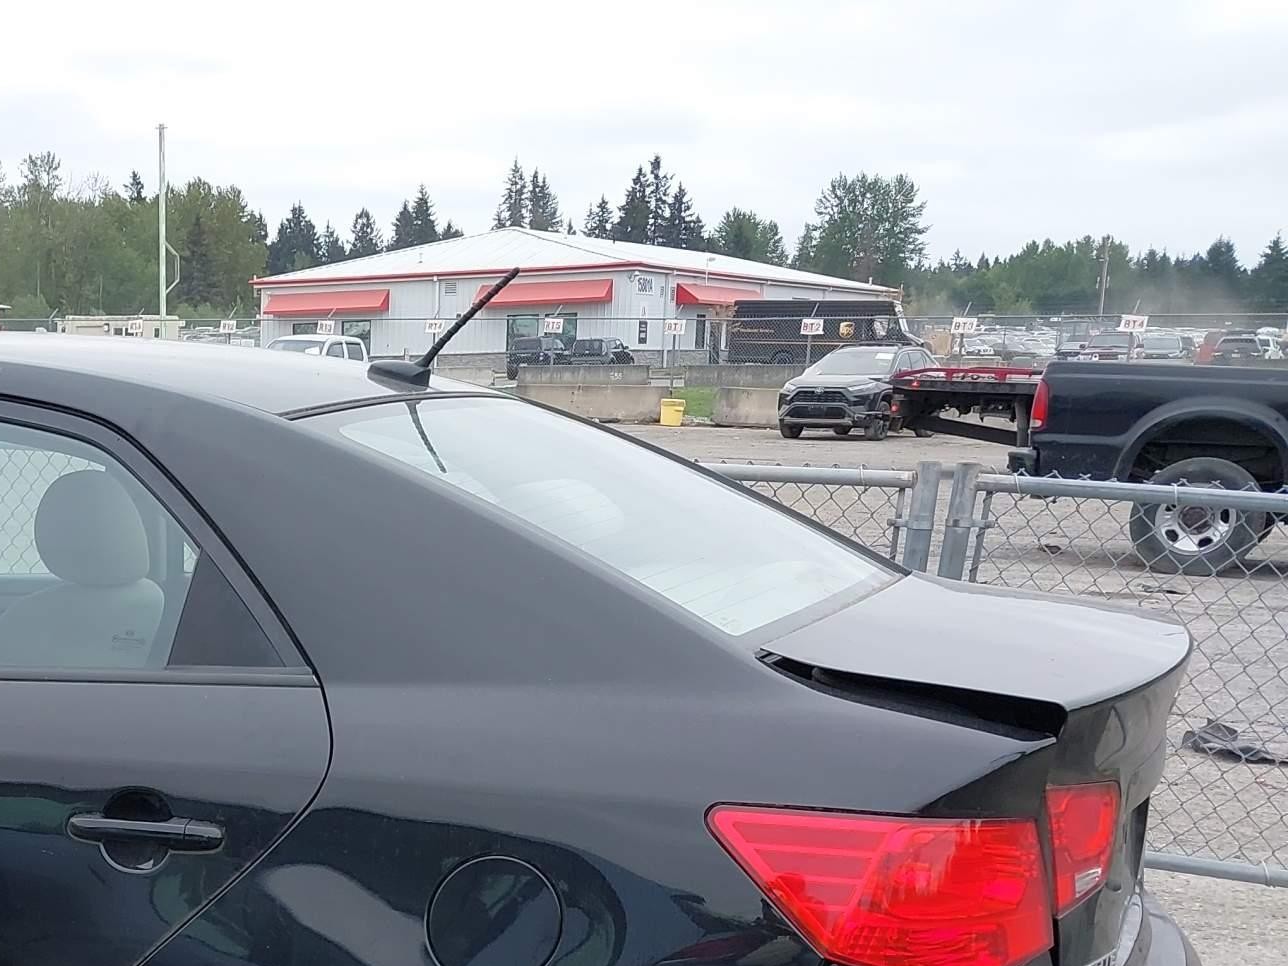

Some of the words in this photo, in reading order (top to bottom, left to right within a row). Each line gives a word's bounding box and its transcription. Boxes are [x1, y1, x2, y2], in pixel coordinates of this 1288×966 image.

[545, 320, 561, 330] RT5
[802, 321, 821, 331] BT2
[1123, 319, 1144, 329] BT4
